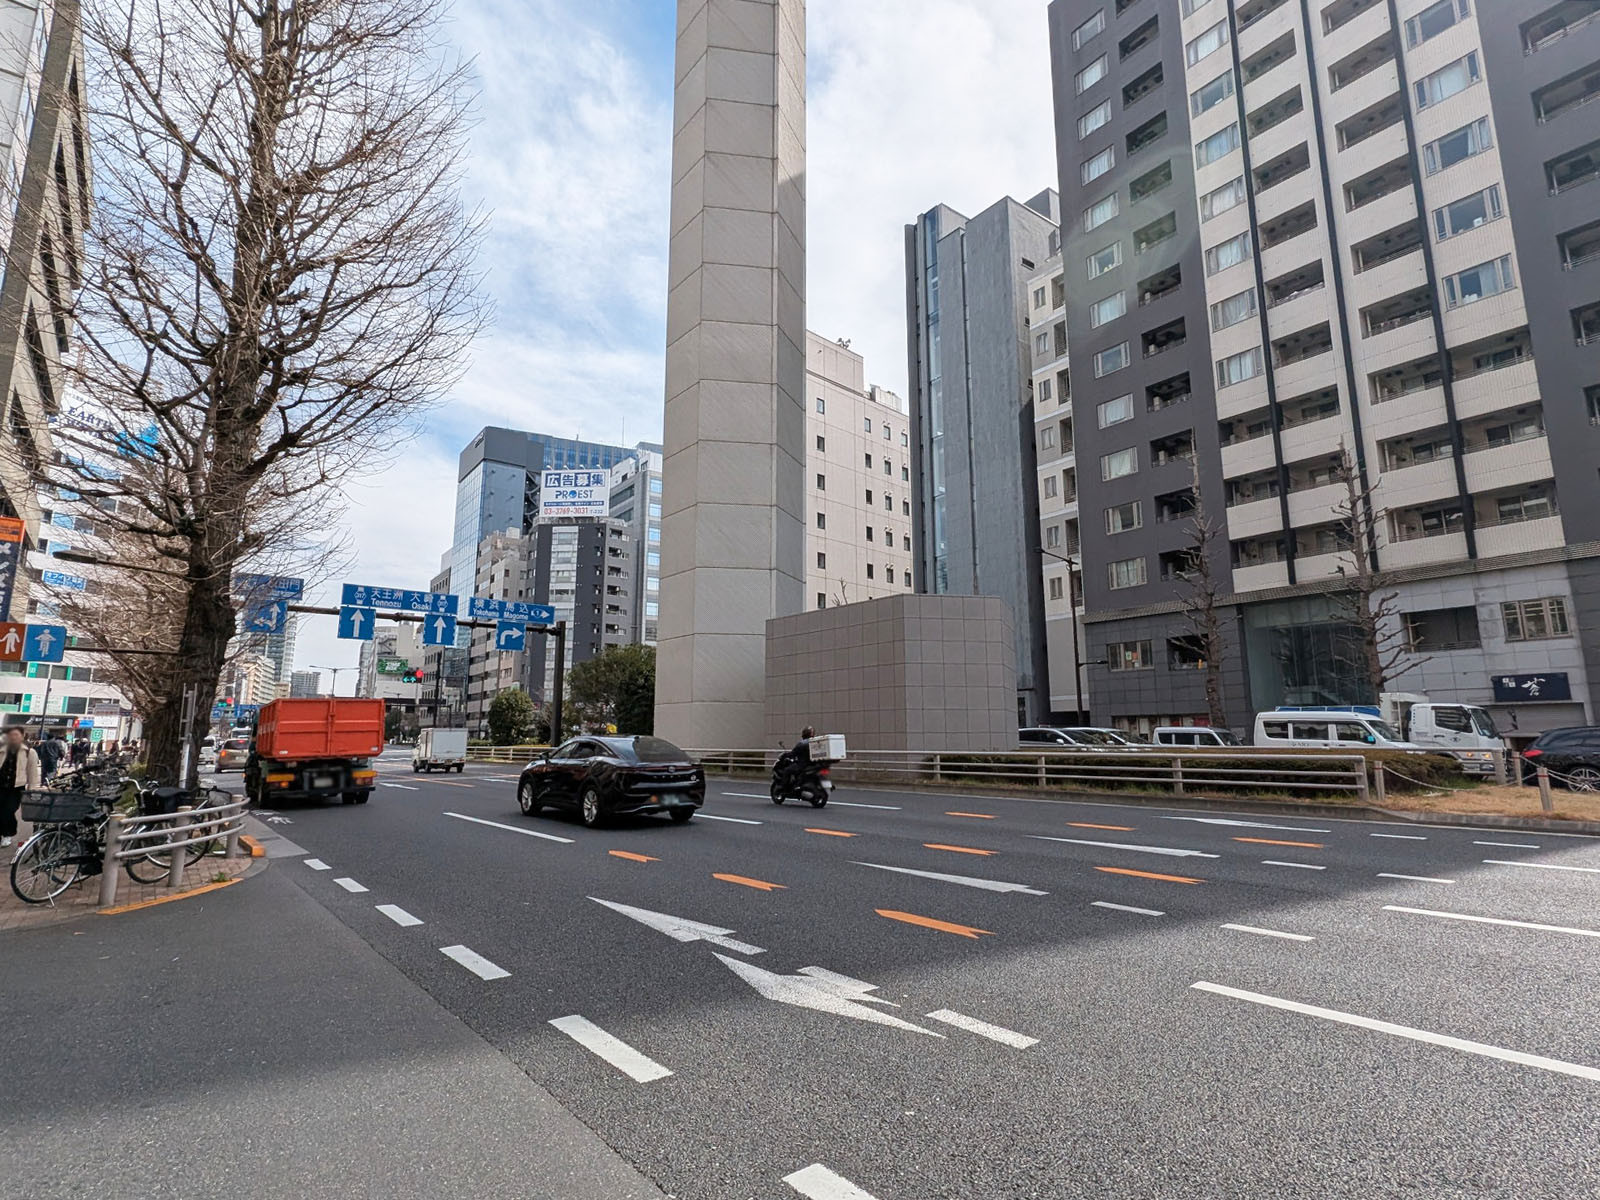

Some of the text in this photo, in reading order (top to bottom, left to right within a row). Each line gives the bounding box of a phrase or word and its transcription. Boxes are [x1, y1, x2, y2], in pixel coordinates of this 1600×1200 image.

[546, 473, 604, 487] 広告募集
[370, 587, 404, 600] 天王洲
[411, 601, 432, 610] Osaki
